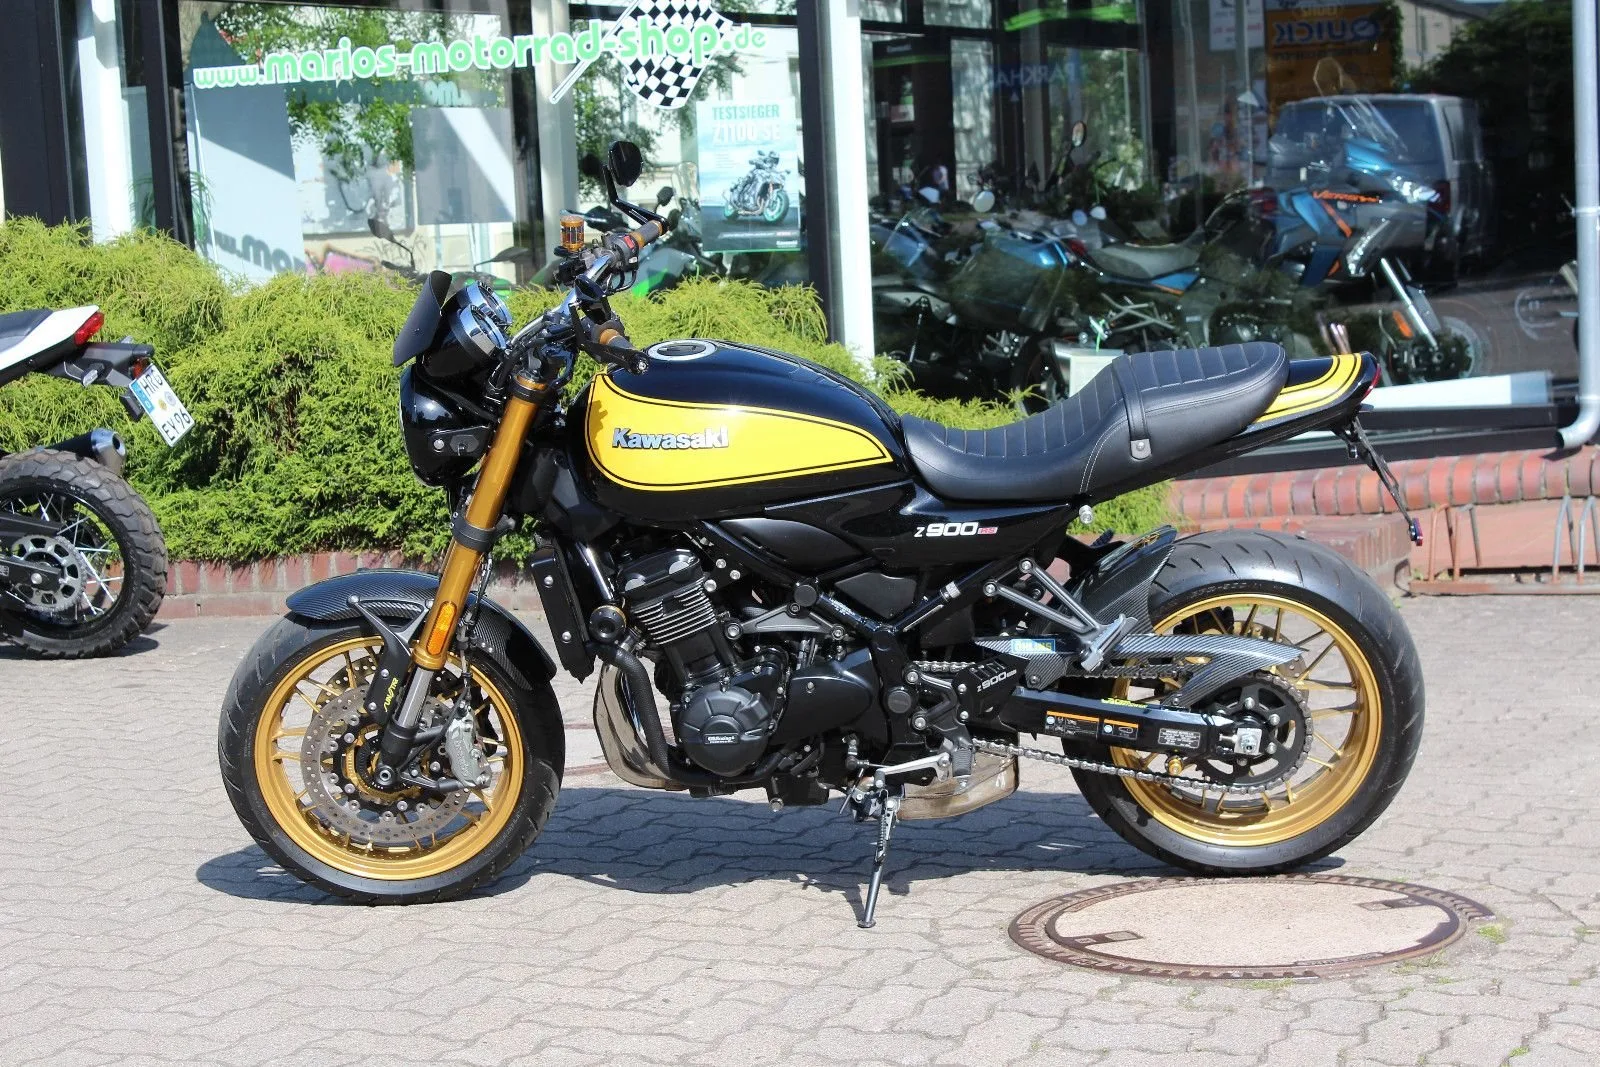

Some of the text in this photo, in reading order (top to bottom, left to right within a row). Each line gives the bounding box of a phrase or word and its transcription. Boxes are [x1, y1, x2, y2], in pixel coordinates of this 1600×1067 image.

[194, 15, 766, 89] www.marios-motorrad-shop.de
[712, 104, 780, 120] TESTSIEGER
[612, 424, 729, 450] Kawasaki
